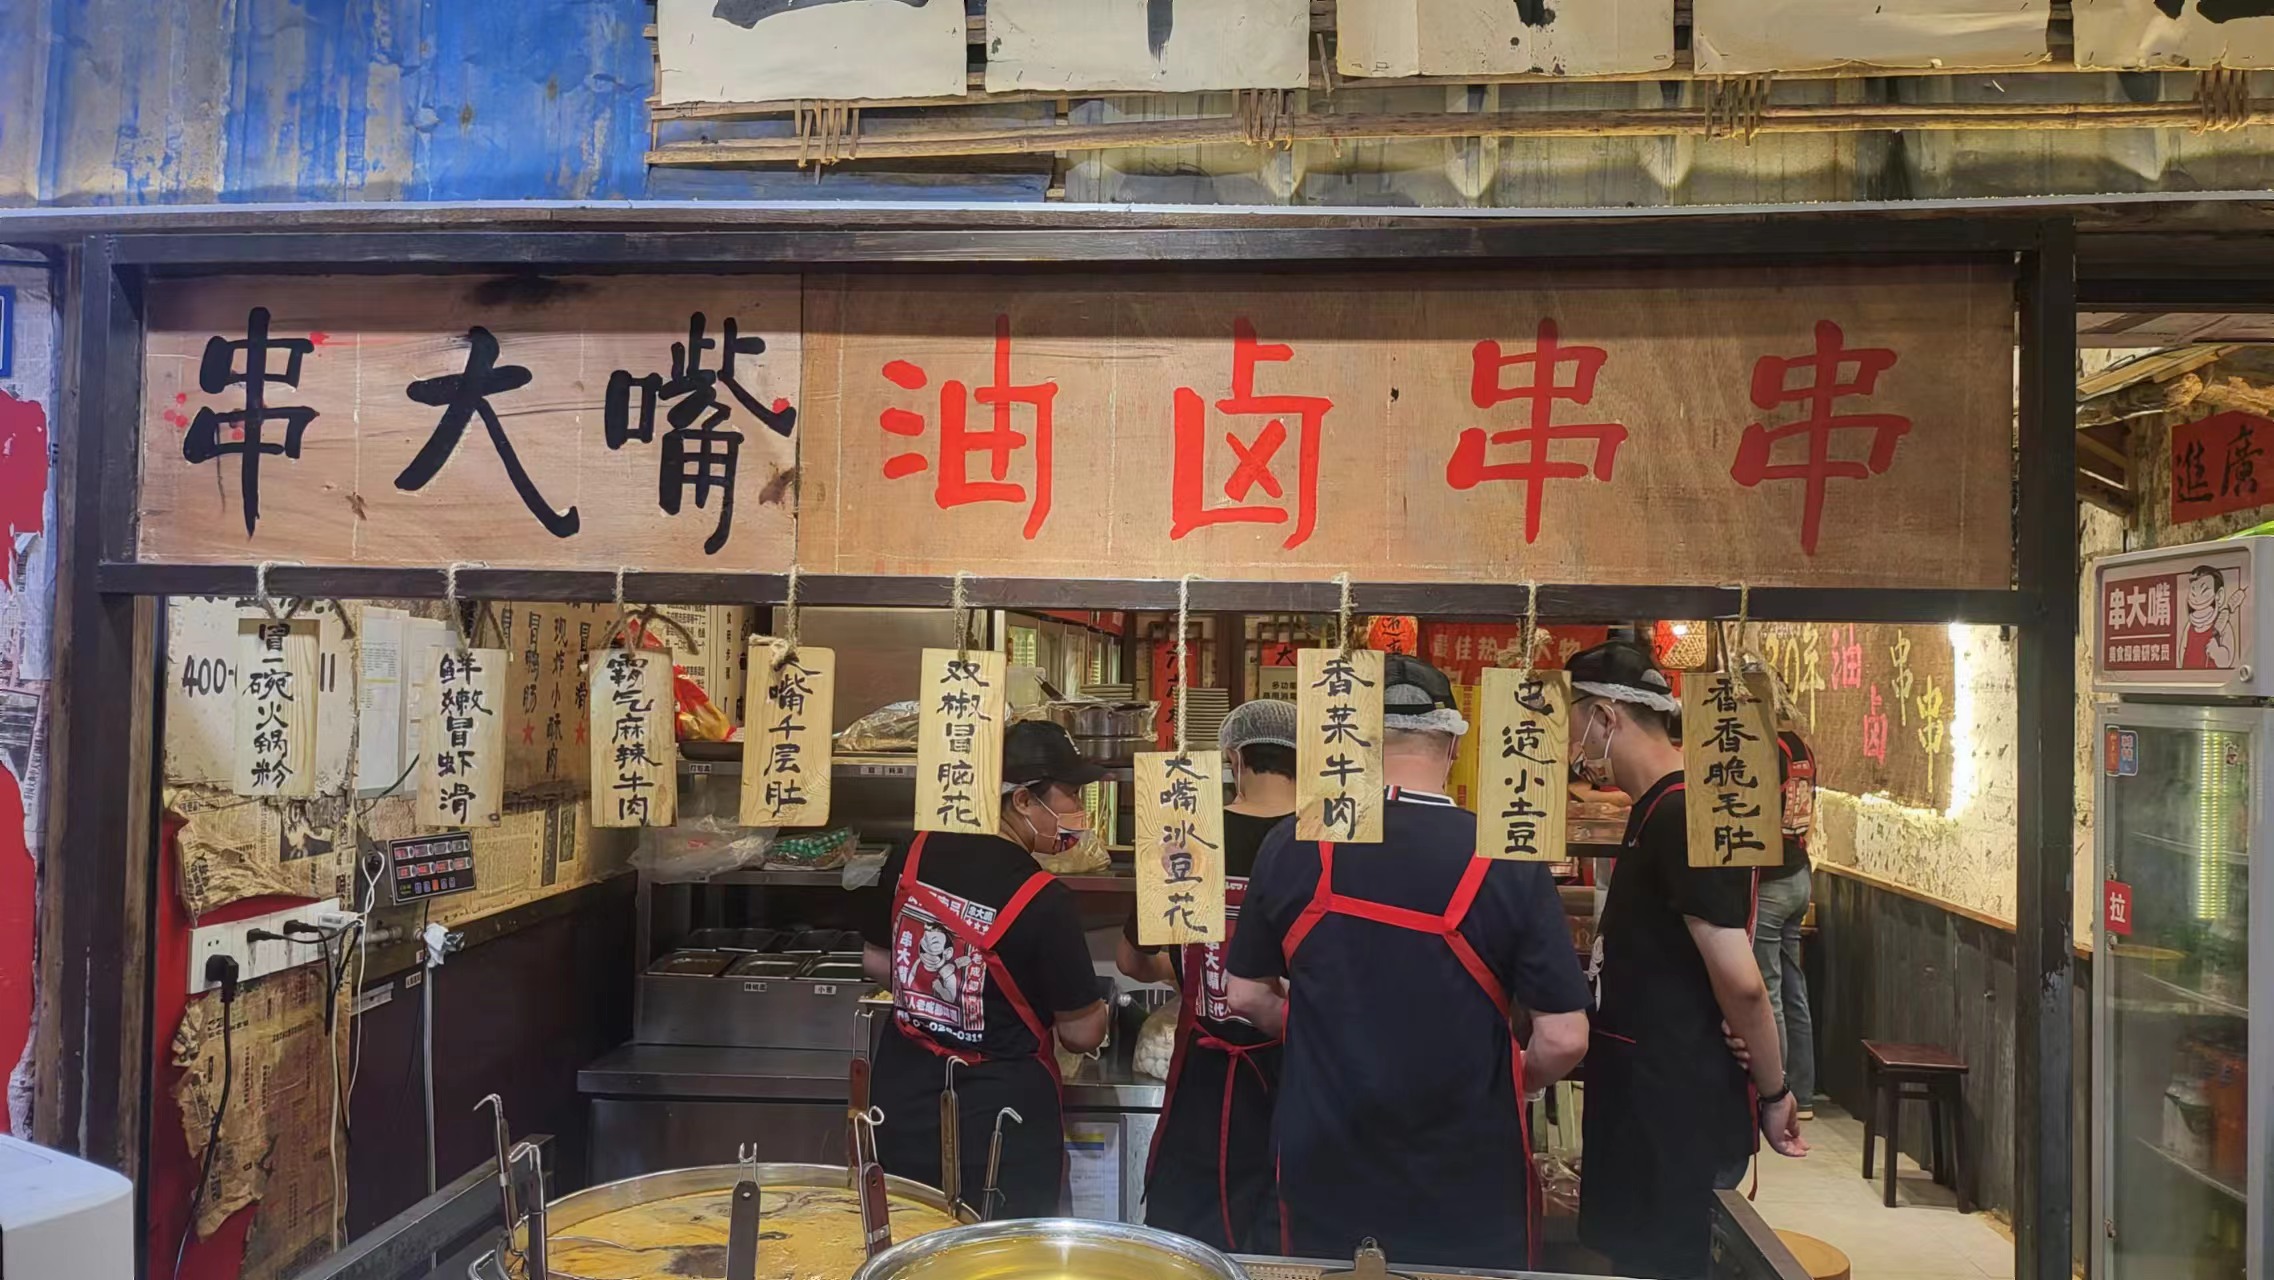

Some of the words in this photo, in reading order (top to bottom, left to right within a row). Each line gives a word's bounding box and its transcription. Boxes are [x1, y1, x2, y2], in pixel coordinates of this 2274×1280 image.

[183, 306, 797, 555] 串大嘴
[880, 312, 1914, 557] 油卤串串
[2108, 581, 2171, 630] 串大嘴
[243, 623, 295, 788] 冒一碗火锅粉
[438, 652, 493, 824] 鲜嫩冒虾滑
[606, 653, 663, 827] 霸气麻辣牛肉
[936, 660, 992, 828] 双椒冒脑花
[1312, 660, 1375, 841] 香菜牛肉
[1501, 679, 1557, 854] 巴适小土豆
[1701, 679, 1766, 865] 香香脆毛肚
[1160, 755, 1219, 934] 大嘴冰豆花
[2109, 891, 2126, 923] 拉
